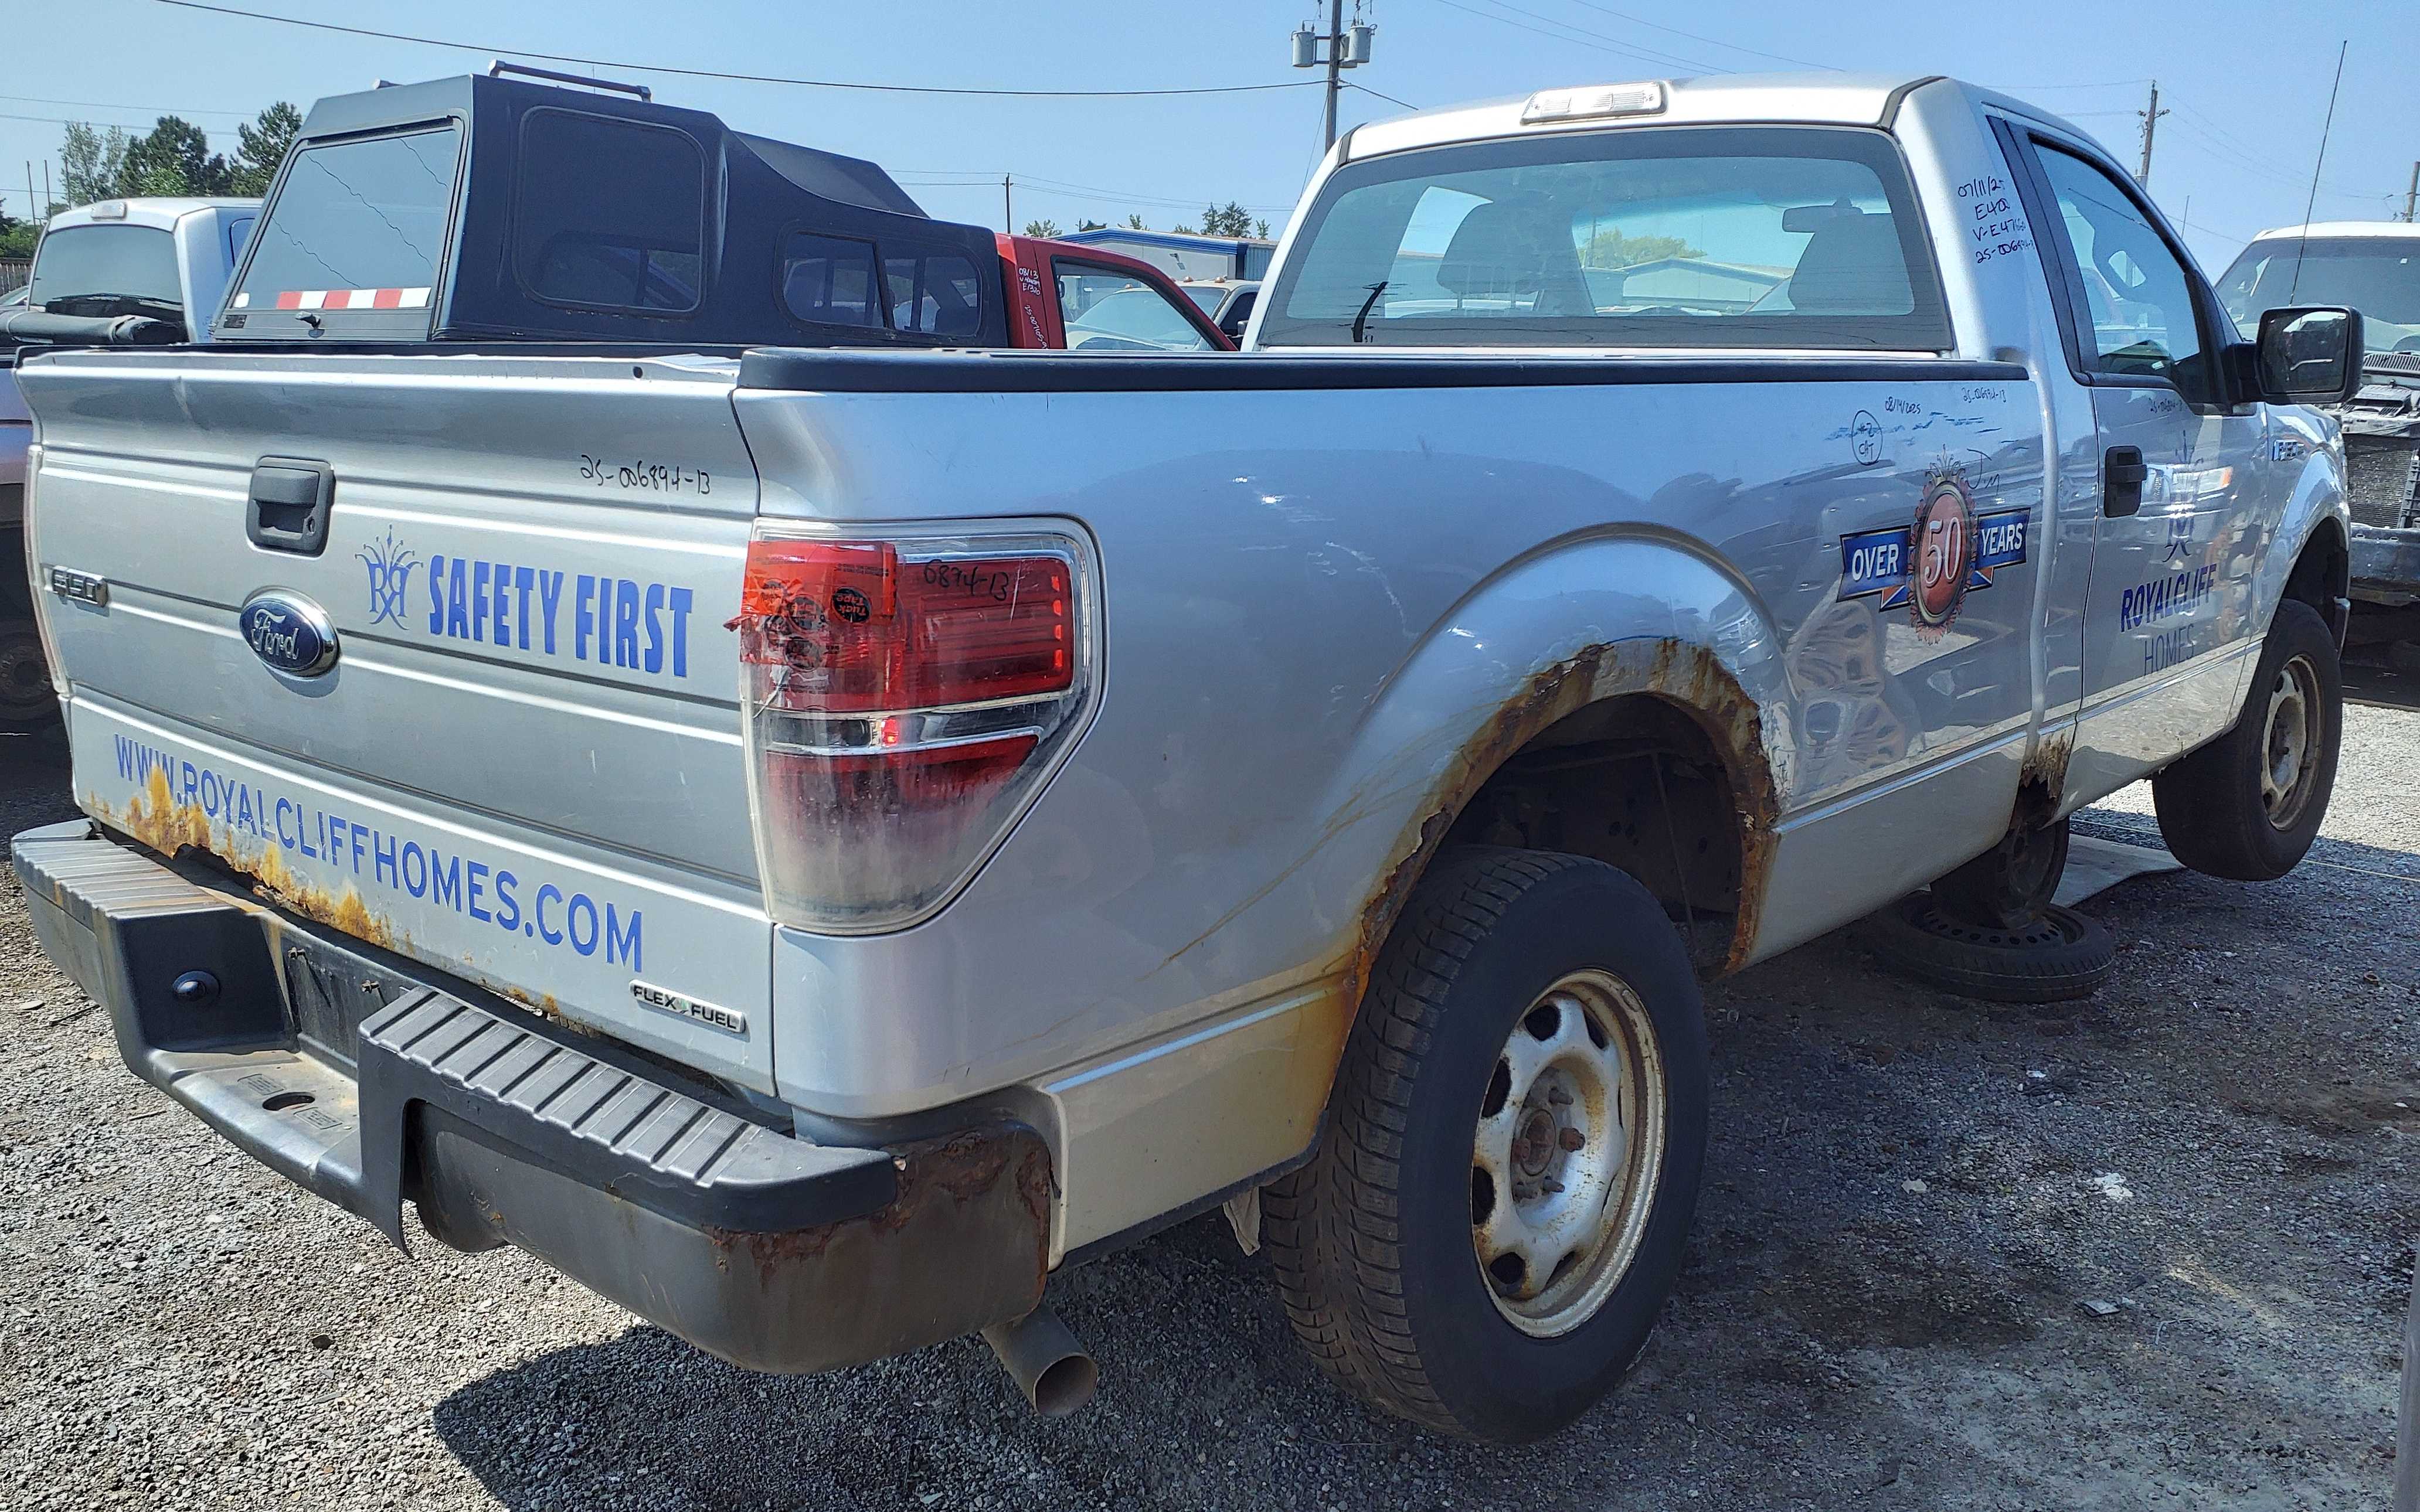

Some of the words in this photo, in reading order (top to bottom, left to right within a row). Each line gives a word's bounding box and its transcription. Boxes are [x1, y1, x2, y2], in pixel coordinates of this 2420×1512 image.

[1851, 543, 1899, 582] OVER
[1923, 516, 1962, 588] 50
[1981, 522, 2023, 557] YEARS
[429, 554, 564, 655] SAFETY
[575, 574, 694, 678] FIRST
[2121, 563, 2217, 633] ROYALCLIFF
[251, 608, 300, 660] Ford
[2144, 623, 2194, 676] HOMES
[115, 734, 643, 973] WWW.ROYALCLIFFHOMES.COM
[633, 985, 677, 1010] FLEX
[691, 1003, 737, 1030] FUEL
